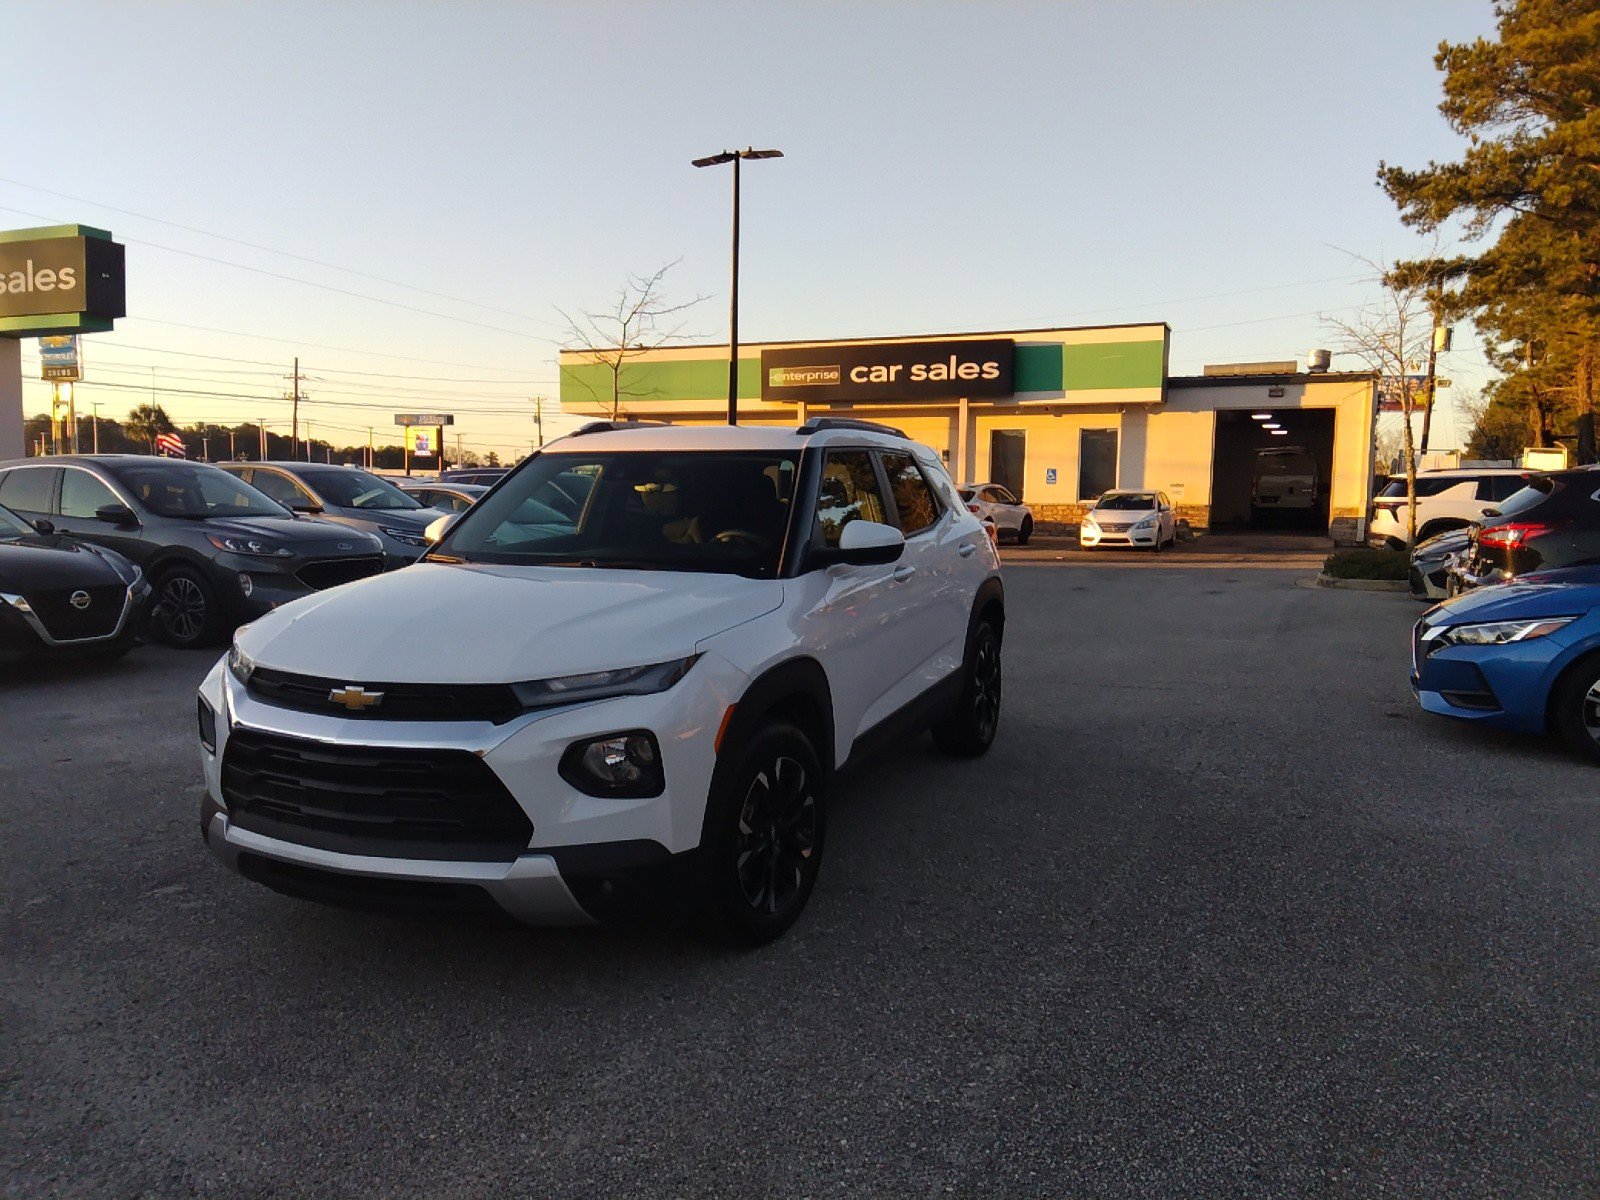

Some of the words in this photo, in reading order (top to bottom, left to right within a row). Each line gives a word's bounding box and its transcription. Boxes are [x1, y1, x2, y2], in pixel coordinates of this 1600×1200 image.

[773, 370, 839, 383] enterprise
[849, 364, 903, 383] car
[909, 354, 1000, 382] sales
